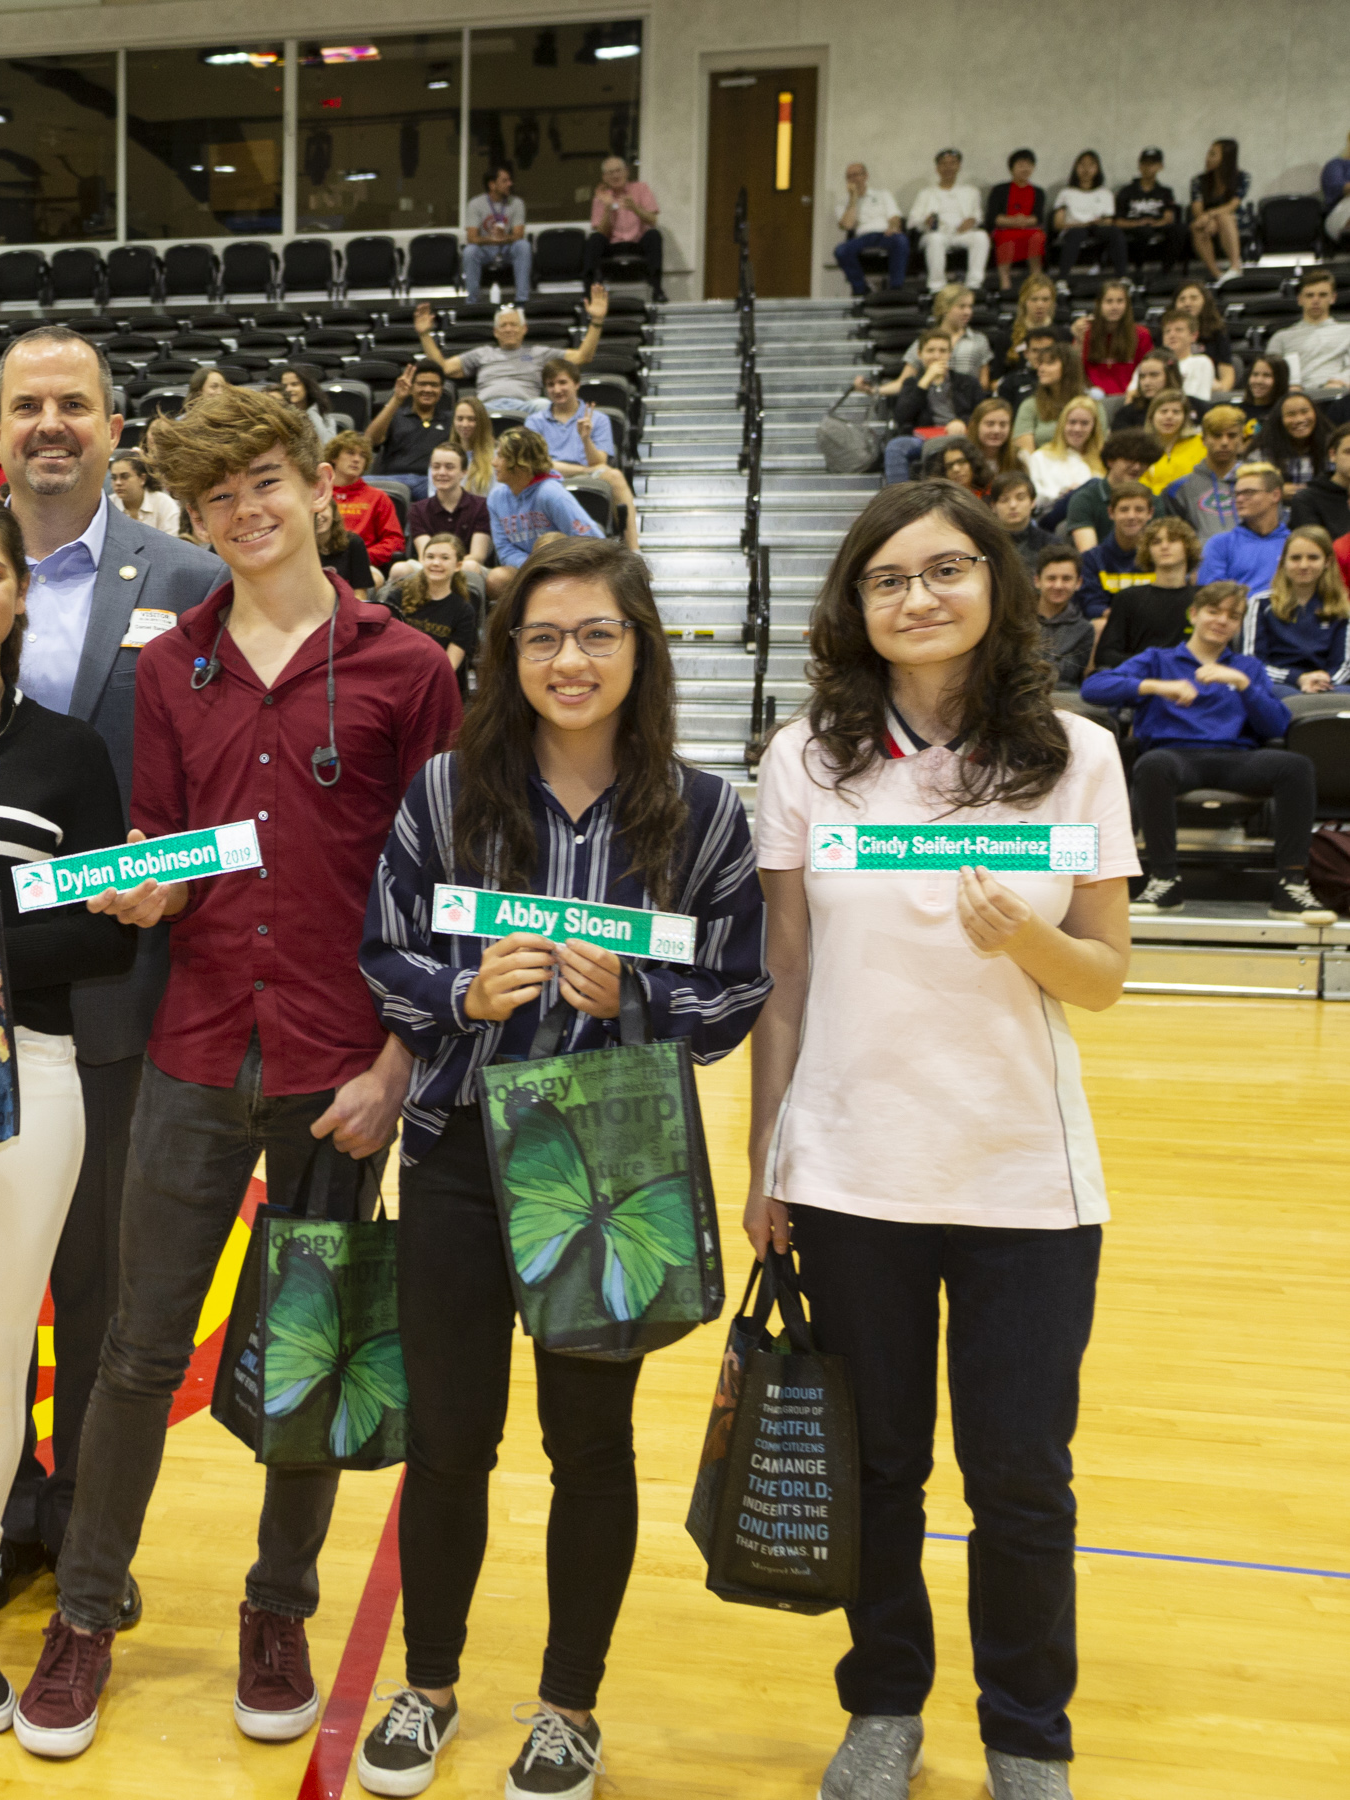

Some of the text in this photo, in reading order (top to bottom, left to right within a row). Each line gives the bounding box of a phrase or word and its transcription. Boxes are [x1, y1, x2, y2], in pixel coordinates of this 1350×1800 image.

[225, 846, 252, 866] 2019
[857, 836, 1049, 859] Cindy Seifert-Ramirez
[1055, 850, 1088, 868] 2019
[56, 844, 217, 896] Dylan Robinson
[495, 899, 633, 941] Abby Sloan
[654, 938, 686, 956] 2019
[811, 1406, 825, 1416] OF
[803, 1504, 828, 1518] THE
[736, 1533, 759, 1552] THAT
[760, 1543, 786, 1558] EVER
